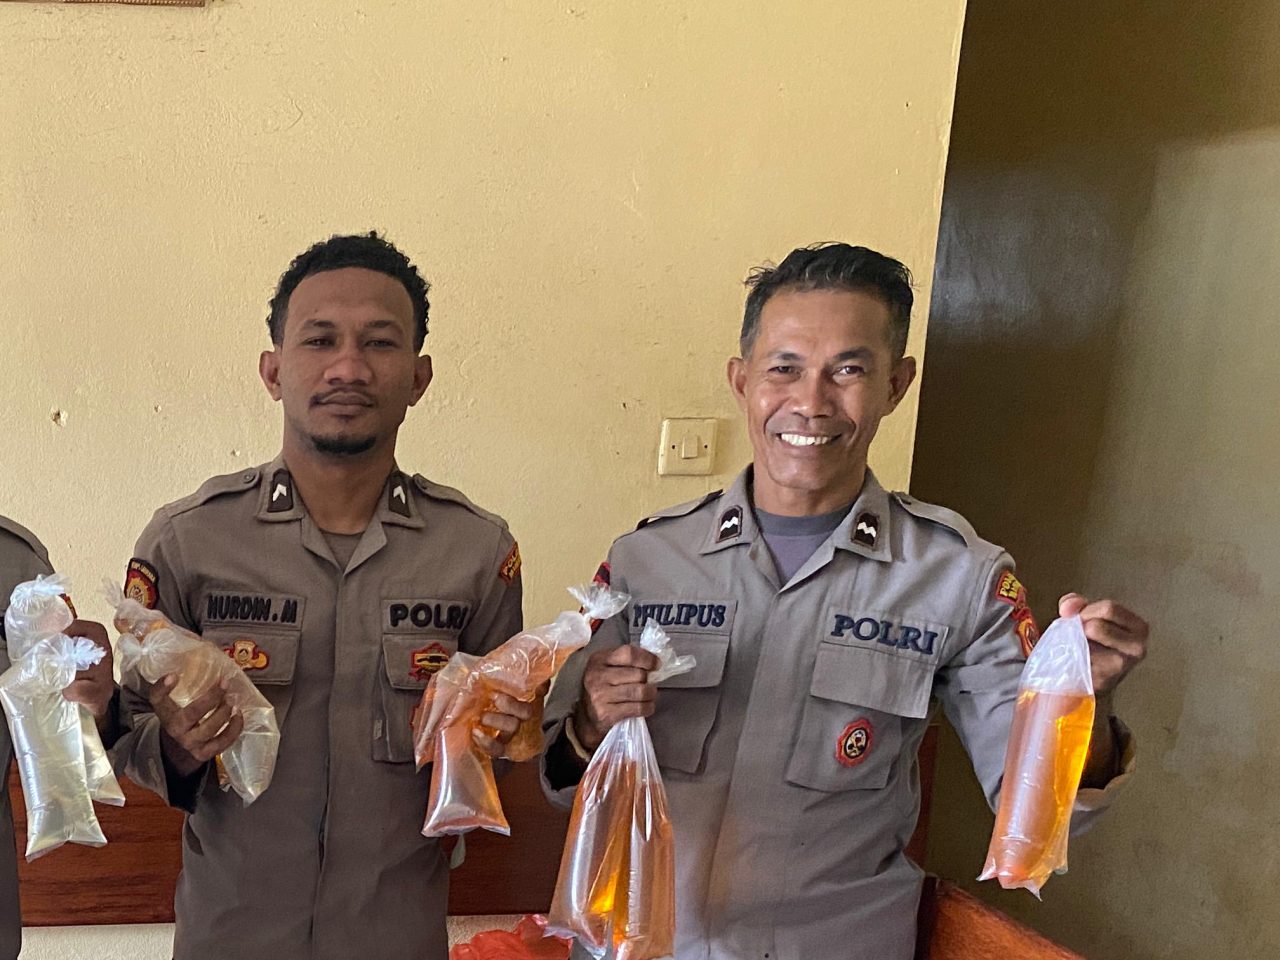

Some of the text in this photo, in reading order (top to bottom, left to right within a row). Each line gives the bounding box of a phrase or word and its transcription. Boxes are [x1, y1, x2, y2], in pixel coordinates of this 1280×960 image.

[389, 602, 469, 630] POLRI
[632, 603, 727, 628] PHILIPUS
[830, 614, 939, 655] POLRI
